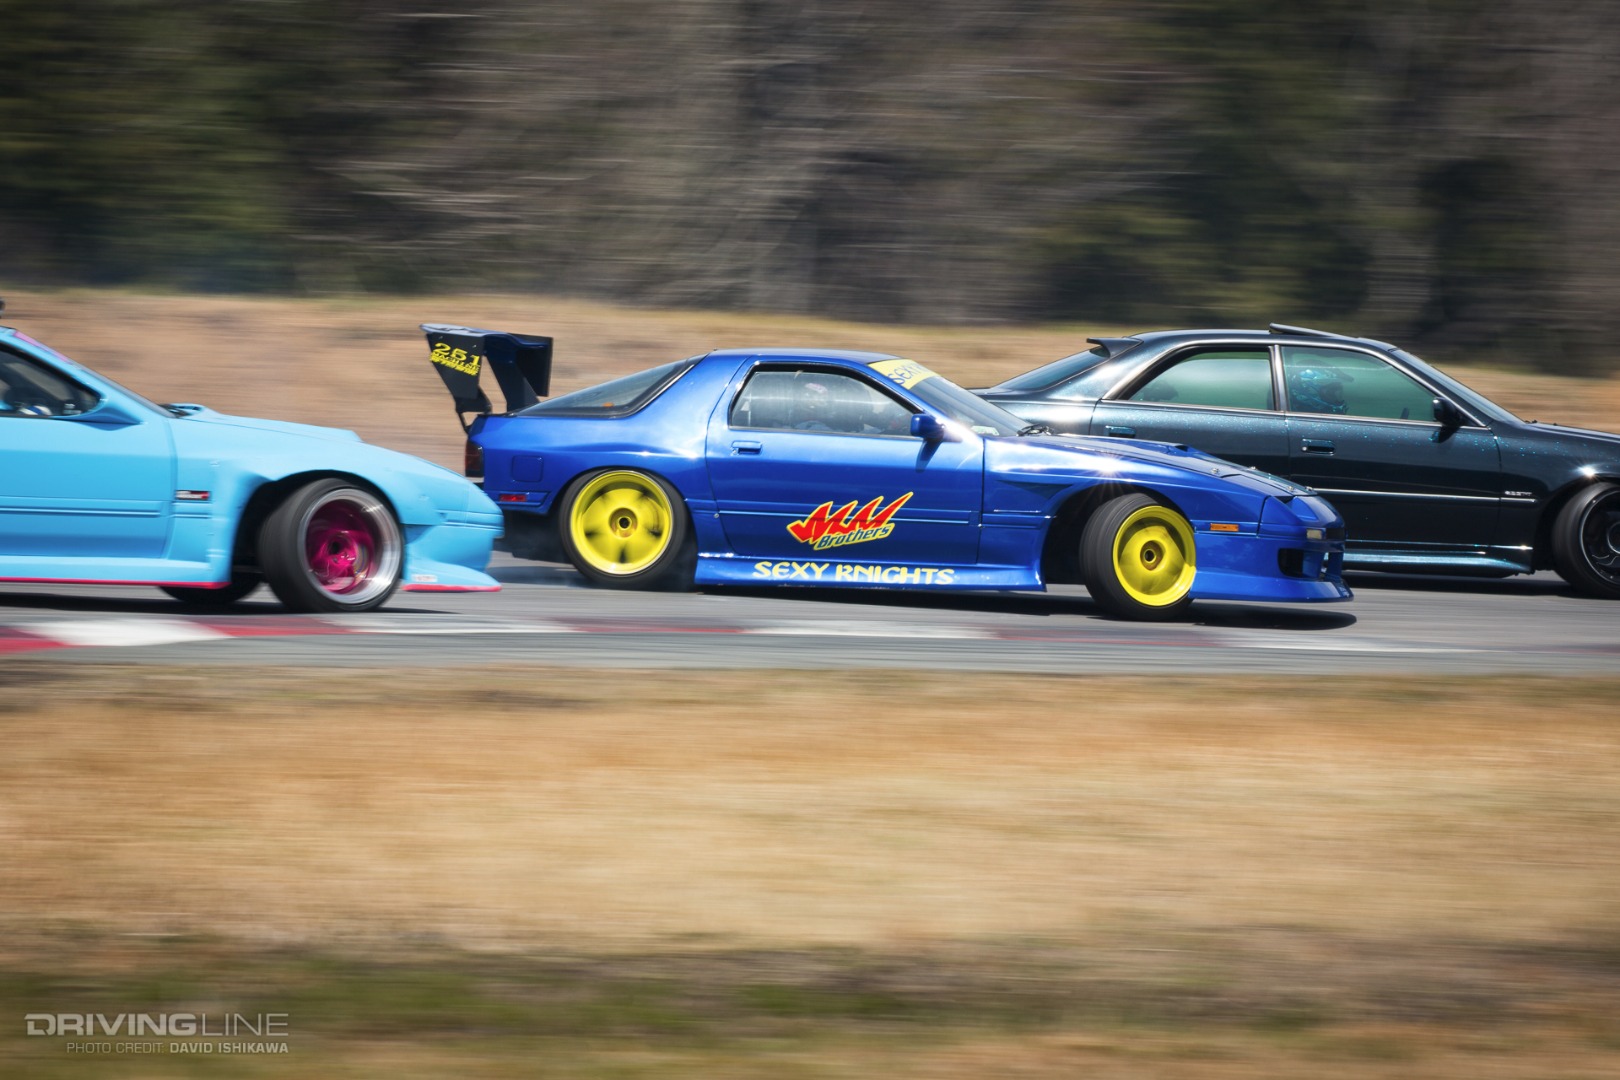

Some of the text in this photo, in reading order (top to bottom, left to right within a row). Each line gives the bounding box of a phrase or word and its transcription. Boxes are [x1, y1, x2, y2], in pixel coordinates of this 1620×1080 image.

[433, 342, 480, 366] 251
[817, 524, 893, 549] Brothers
[752, 561, 955, 585] SEXY KNIGHTS
